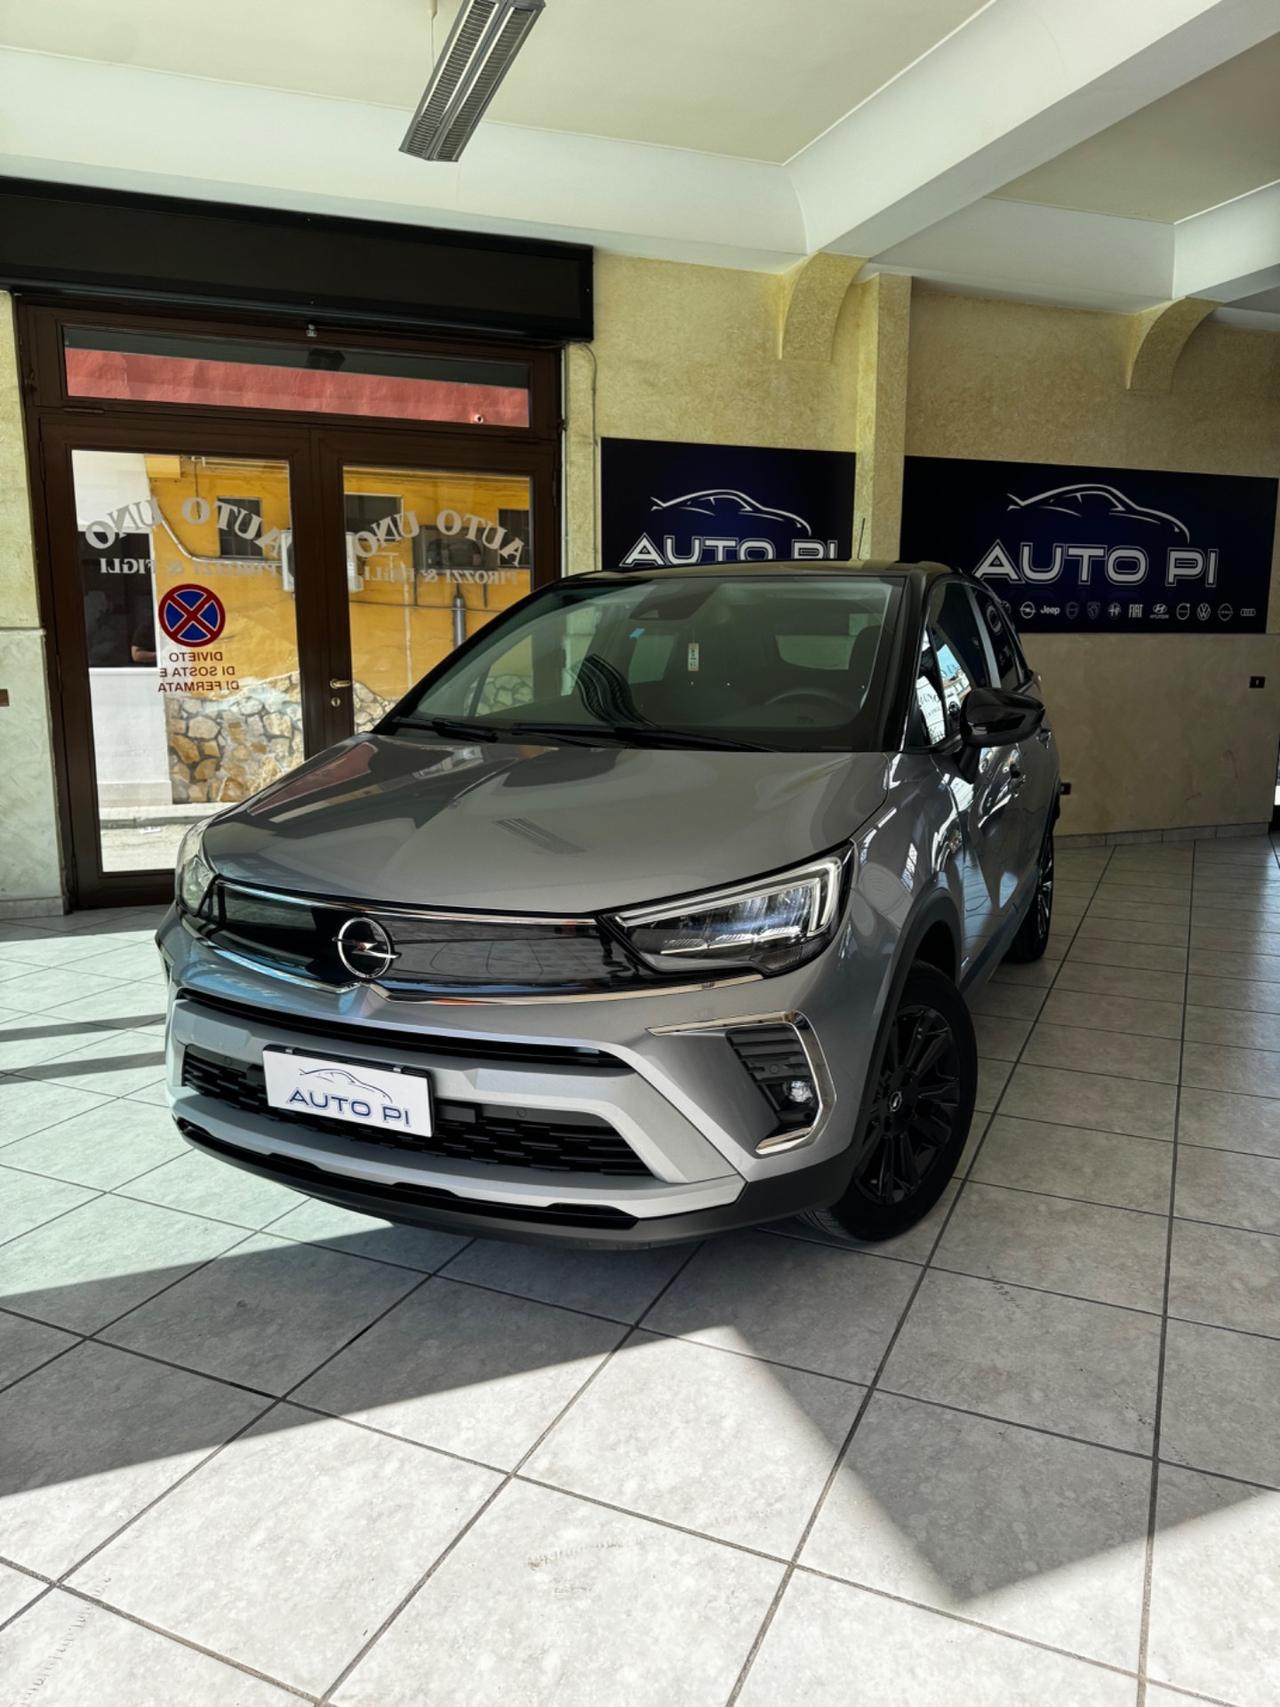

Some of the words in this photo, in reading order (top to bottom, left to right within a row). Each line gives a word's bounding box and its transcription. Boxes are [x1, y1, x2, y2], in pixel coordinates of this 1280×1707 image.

[619, 532, 775, 566] AUTO
[792, 538, 838, 560] PI
[973, 539, 1149, 585] AUTO
[1166, 547, 1218, 587] PI
[1040, 605, 1060, 616] Jeep
[287, 1086, 372, 1119] AUTO
[381, 1103, 411, 1127] PI
